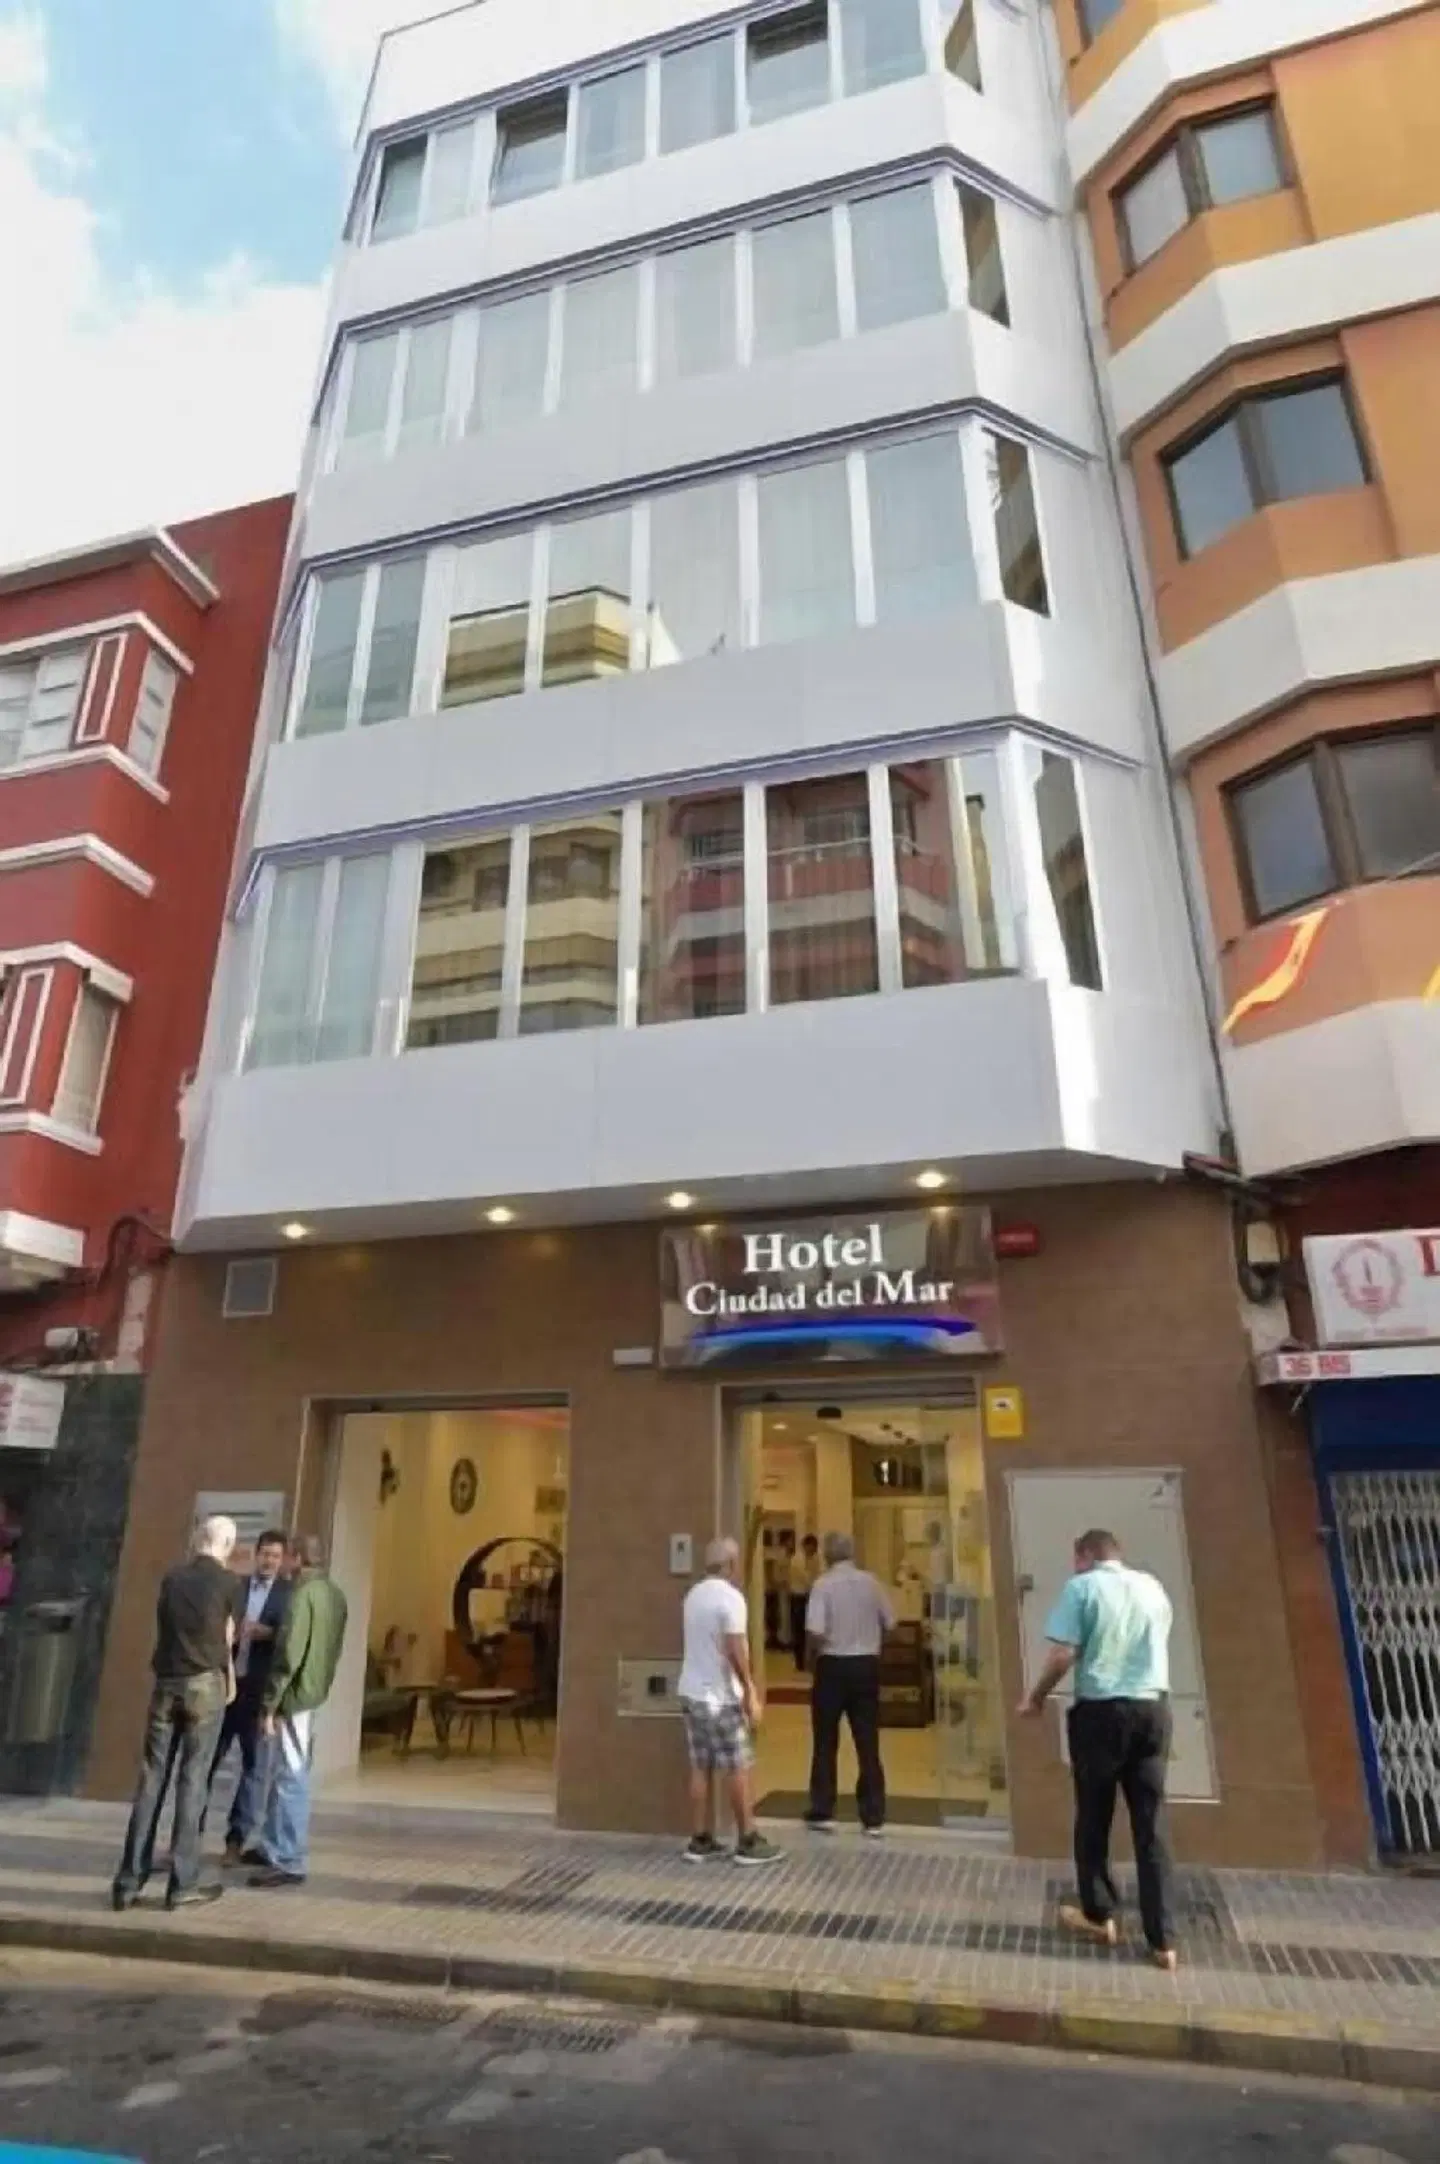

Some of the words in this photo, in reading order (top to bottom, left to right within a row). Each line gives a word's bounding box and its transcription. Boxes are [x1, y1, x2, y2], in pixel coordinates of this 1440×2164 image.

[743, 1223, 884, 1273] Hotel
[687, 1282, 806, 1315] Ciudad
[816, 1279, 864, 1308] del
[872, 1269, 953, 1304] Mar
